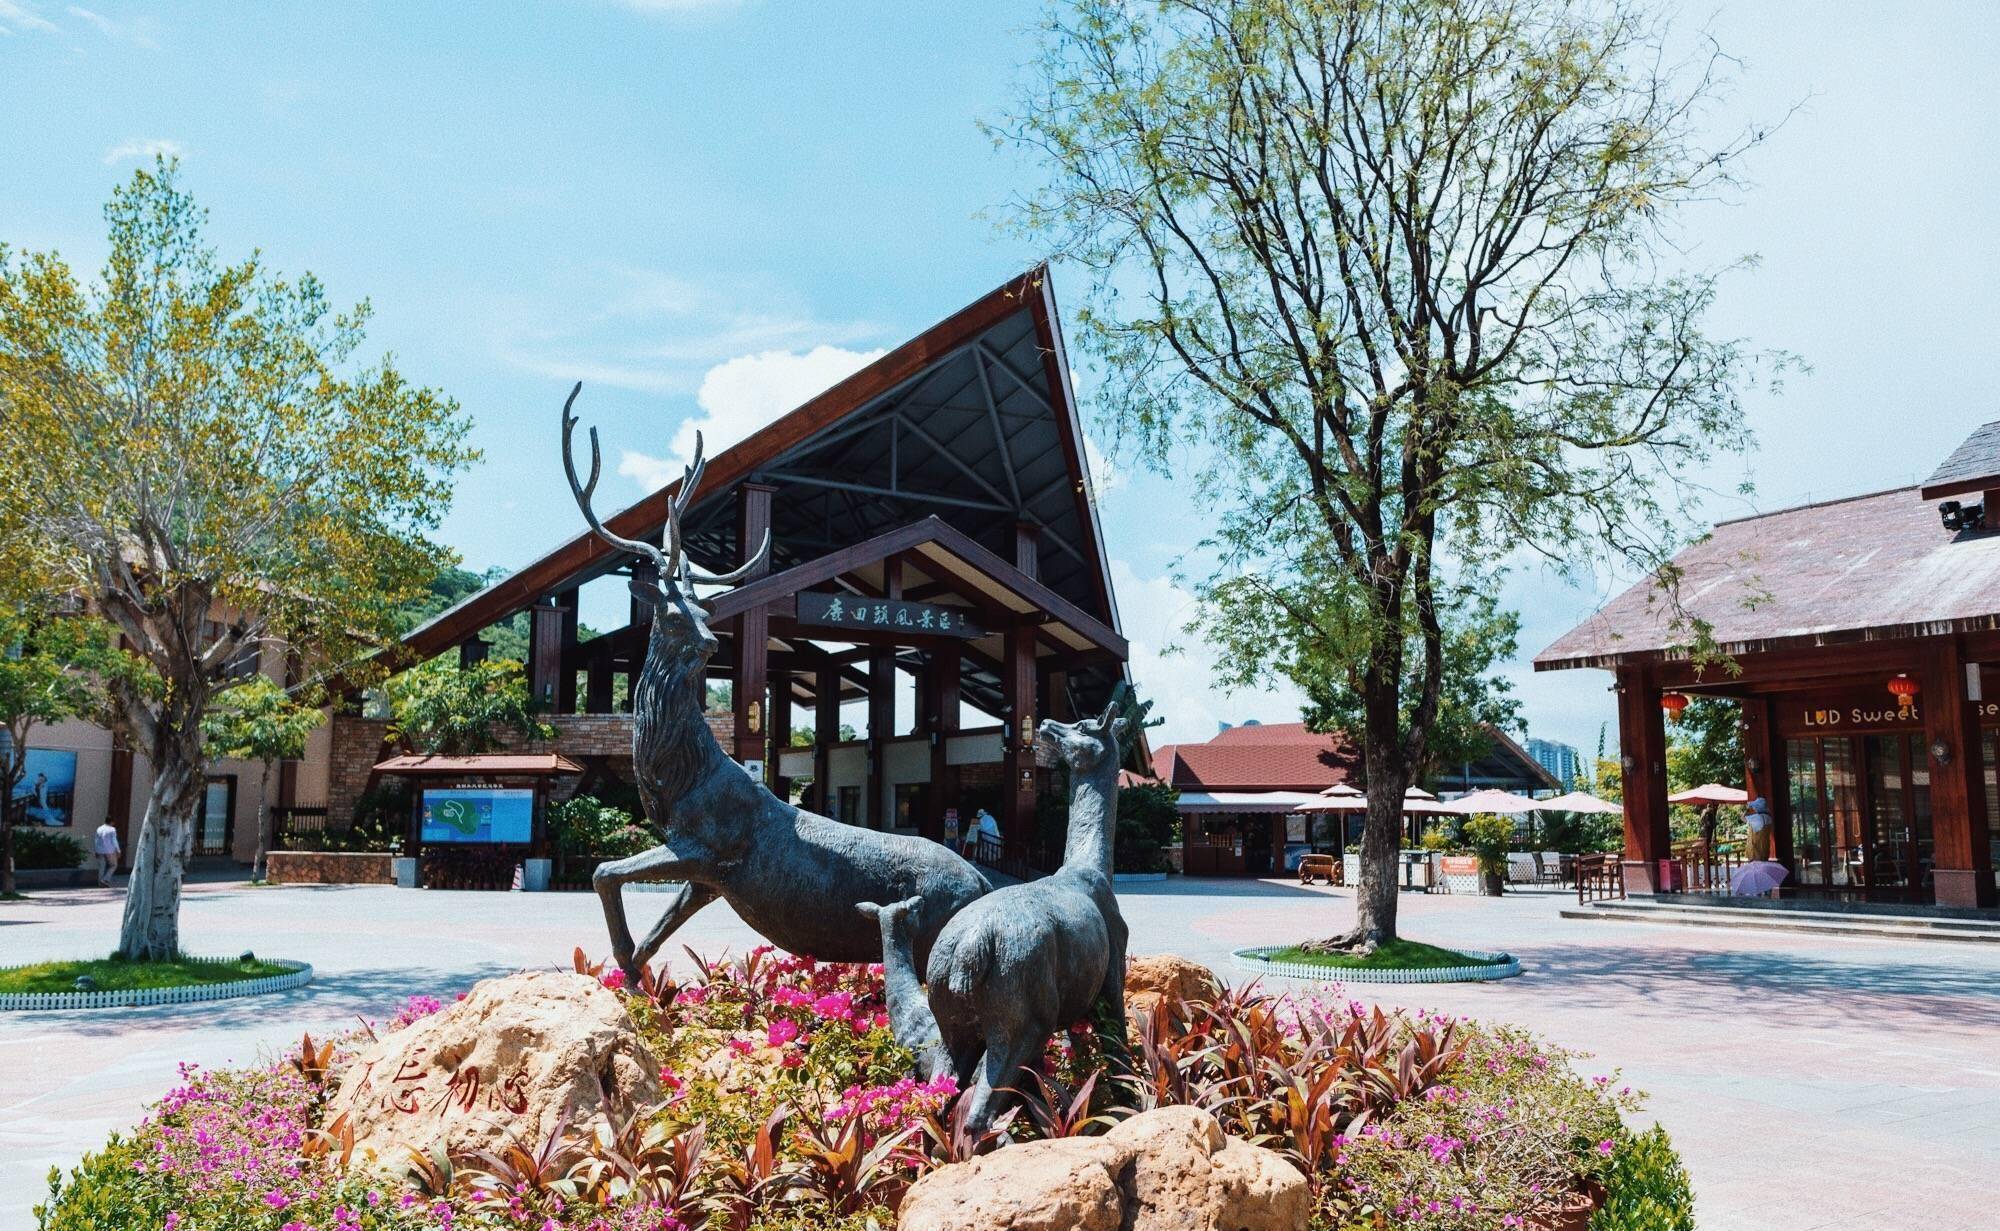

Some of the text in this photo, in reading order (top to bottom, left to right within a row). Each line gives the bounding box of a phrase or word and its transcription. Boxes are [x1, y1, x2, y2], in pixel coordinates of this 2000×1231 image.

[1804, 709, 1841, 726] LUD
[1852, 705, 1919, 724] Sweet
[350, 1047, 530, 1117] 不忘初心
